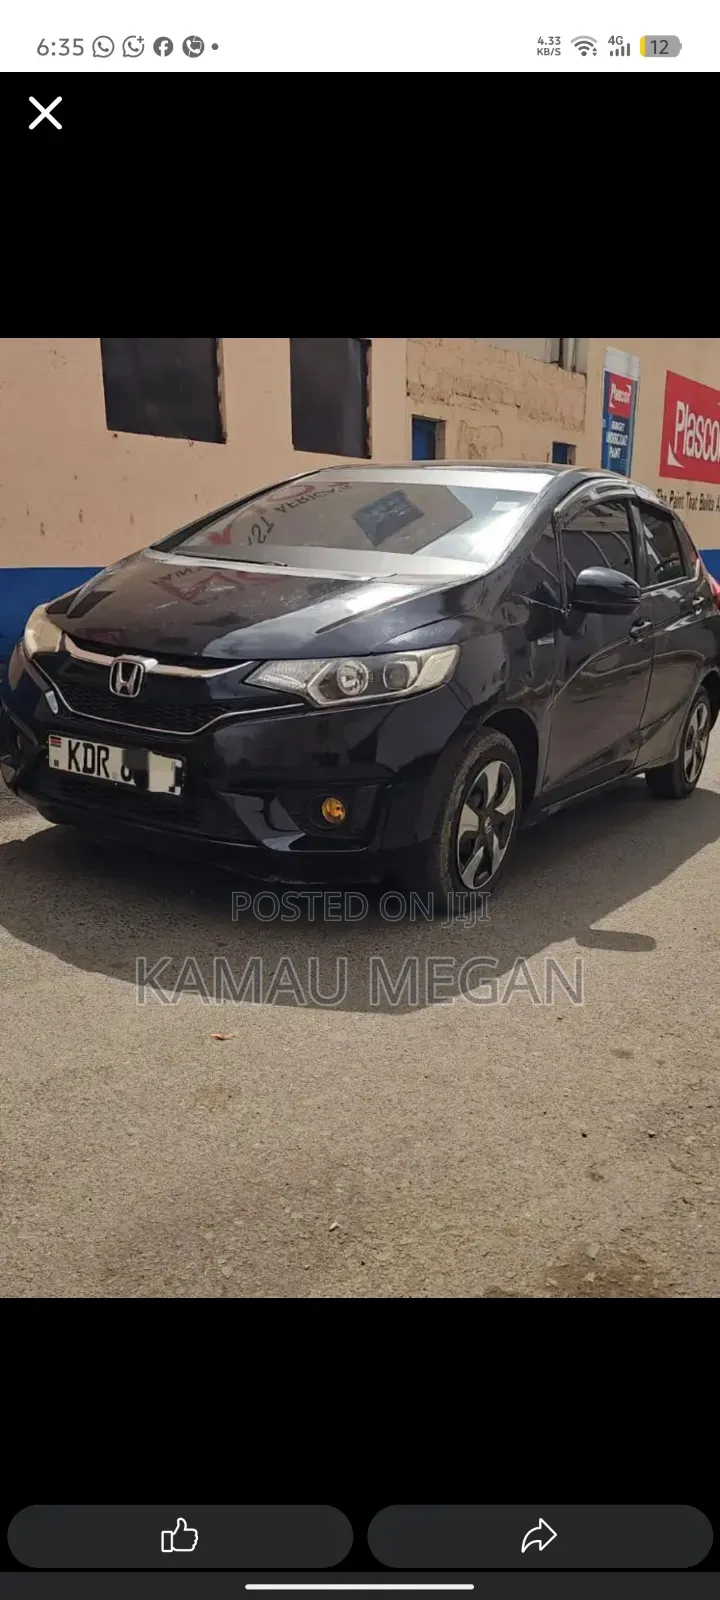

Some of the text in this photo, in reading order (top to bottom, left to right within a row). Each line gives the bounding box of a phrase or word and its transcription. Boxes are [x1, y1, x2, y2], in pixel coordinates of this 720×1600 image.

[37, 38, 84, 56] 6:35
[537, 36, 561, 45] 4.33
[608, 35, 624, 45] 4G
[650, 40, 669, 55] 12
[537, 48, 561, 56] KB/S
[674, 400, 720, 463] Plasco
[669, 489, 684, 509] Paint
[686, 491, 698, 510] That
[68, 740, 110, 778] KDR
